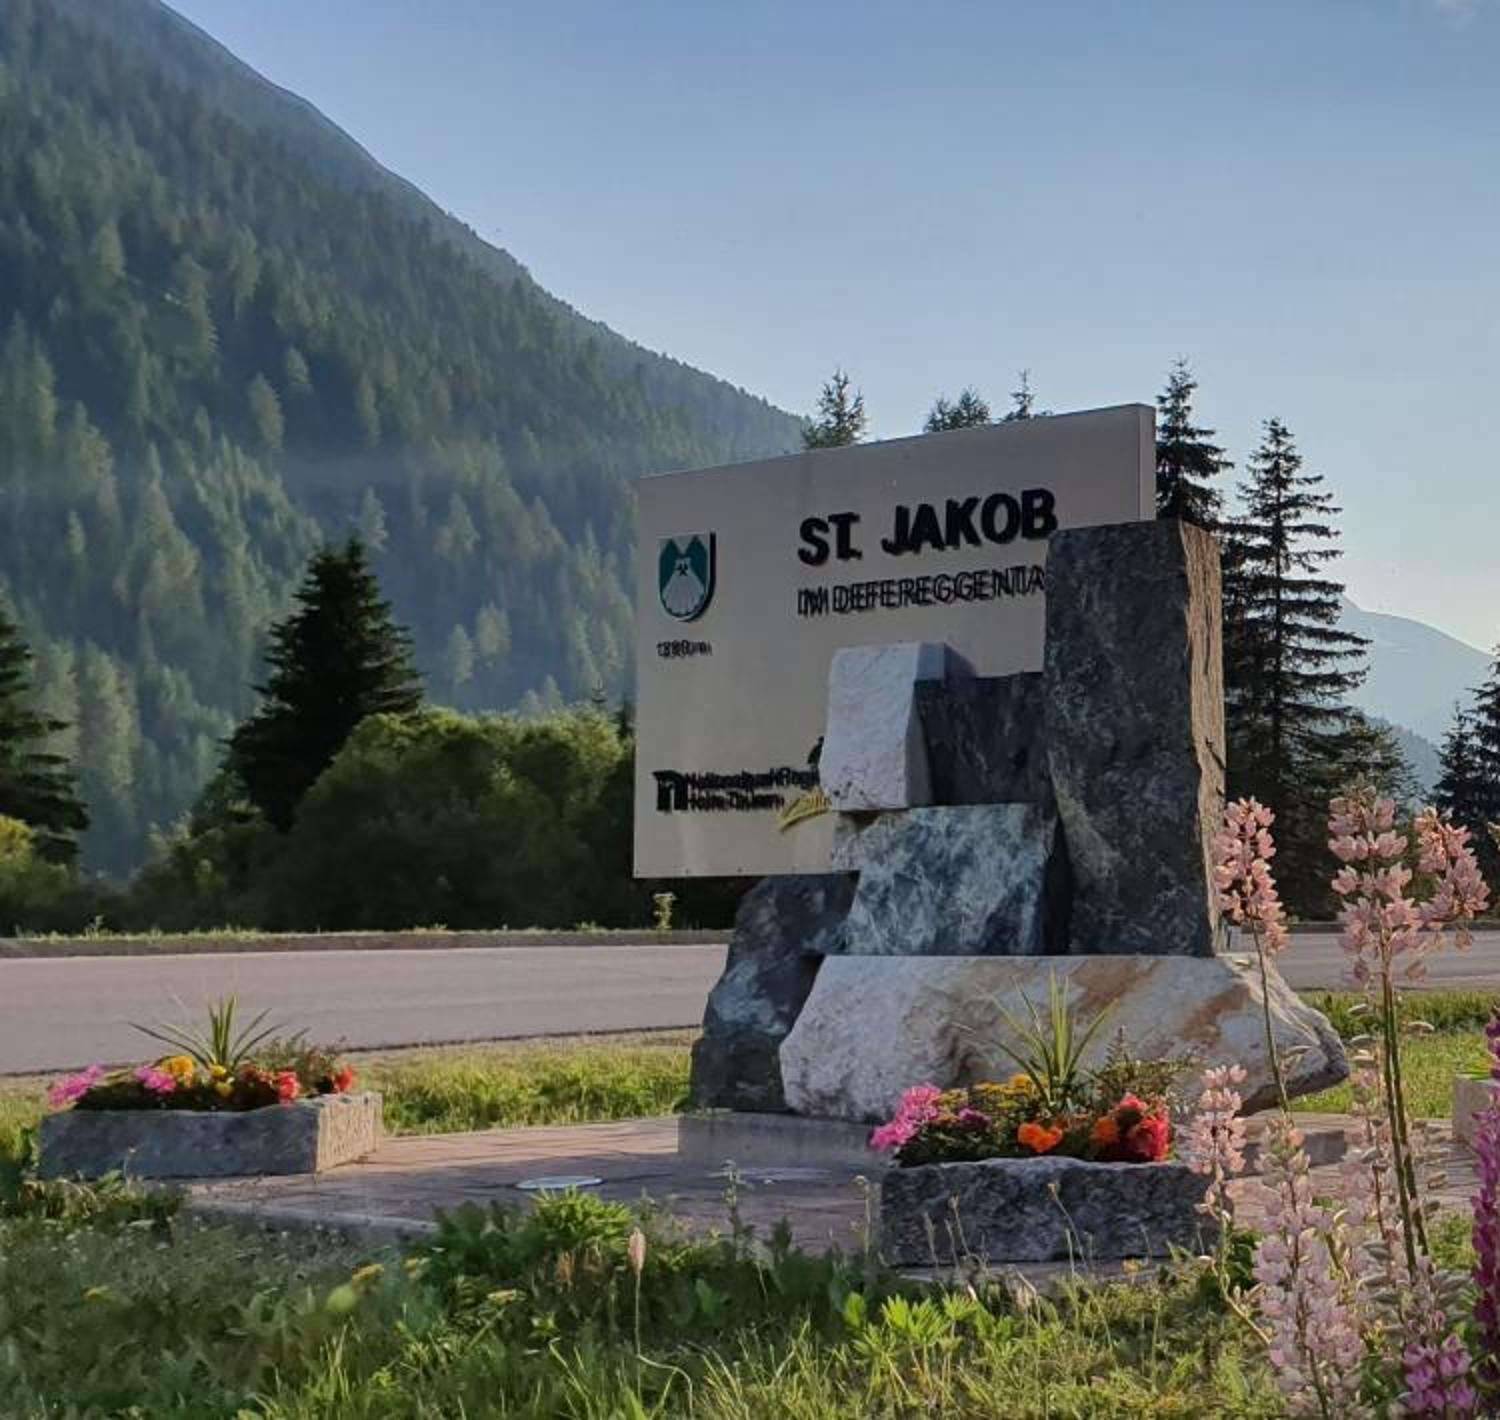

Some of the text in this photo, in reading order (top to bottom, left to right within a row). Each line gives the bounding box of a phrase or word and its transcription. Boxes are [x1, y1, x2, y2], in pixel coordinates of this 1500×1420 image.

[798, 488, 1058, 566] ST. JAKOB
[832, 565, 1046, 614] DEFEREGGENTA
